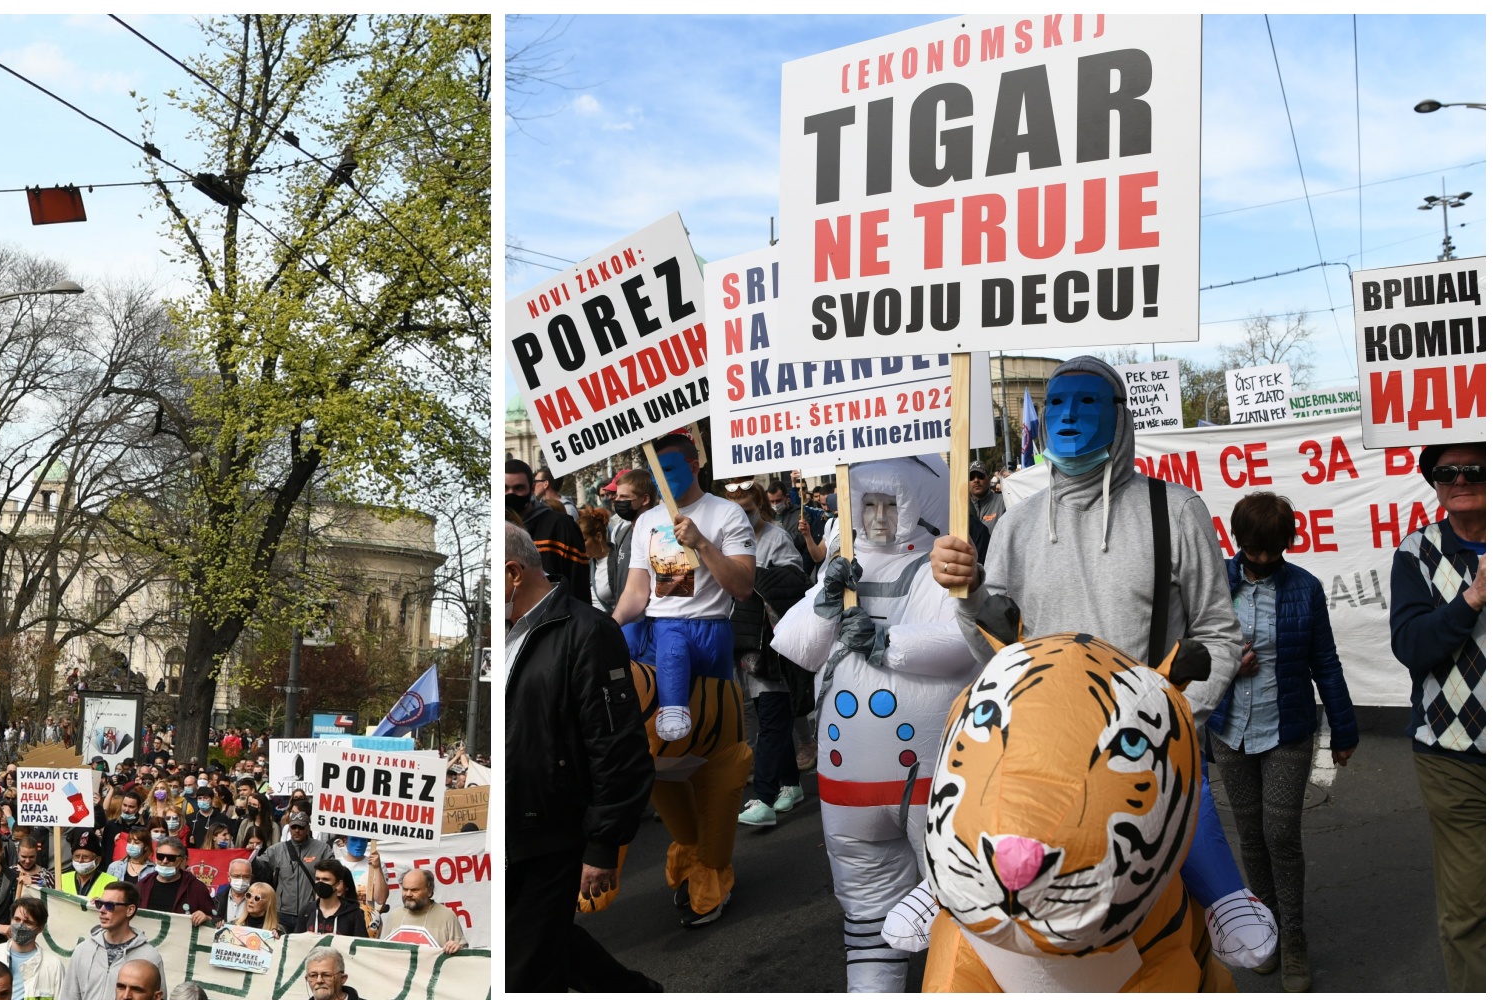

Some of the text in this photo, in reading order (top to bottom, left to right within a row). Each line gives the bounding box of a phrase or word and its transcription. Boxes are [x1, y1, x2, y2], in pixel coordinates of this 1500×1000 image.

[803, 48, 1153, 206] TIGAR
[813, 170, 1160, 284] NE TRUJE
[526, 247, 646, 320] NOVI ZAKON:
[1362, 269, 1481, 313] ВРШАЦ
[811, 281, 961, 341] SVOJU
[981, 264, 1161, 329] DECU!
[511, 256, 697, 391] POREZ
[533, 386, 584, 435] NA
[577, 322, 709, 414] VAZDUH
[1126, 370, 1170, 384] PEK BEZ
[1130, 383, 1165, 395] OTROVA
[1234, 373, 1284, 392] ČIST PEK
[1165, 394, 1169, 402] I
[1236, 388, 1285, 406] JE ZLATO
[1289, 396, 1313, 410] NIJE
[1314, 393, 1332, 407] BITNA
[551, 376, 710, 463] 5 GODINA UNAZA
[730, 385, 953, 439] MODEL: ŠETNJA 2022
[1161, 418, 1178, 427] NEGO
[731, 440, 785, 465] Hvala
[791, 429, 845, 457] braći
[1219, 436, 1360, 489] СЕ ЗА
[341, 752, 421, 770] NOVI ZAKON:
[20, 781, 56, 793] НАШОЈ
[62, 771, 79, 781] СТЕ
[321, 762, 437, 802] POREZ
[20, 793, 49, 804] ДЕЦИ
[20, 803, 48, 814] ДЕДА
[318, 793, 435, 826] NA VAZDUH
[21, 814, 59, 824] МРАЗА!
[317, 814, 435, 841] 5 GODINA UNAZAD
